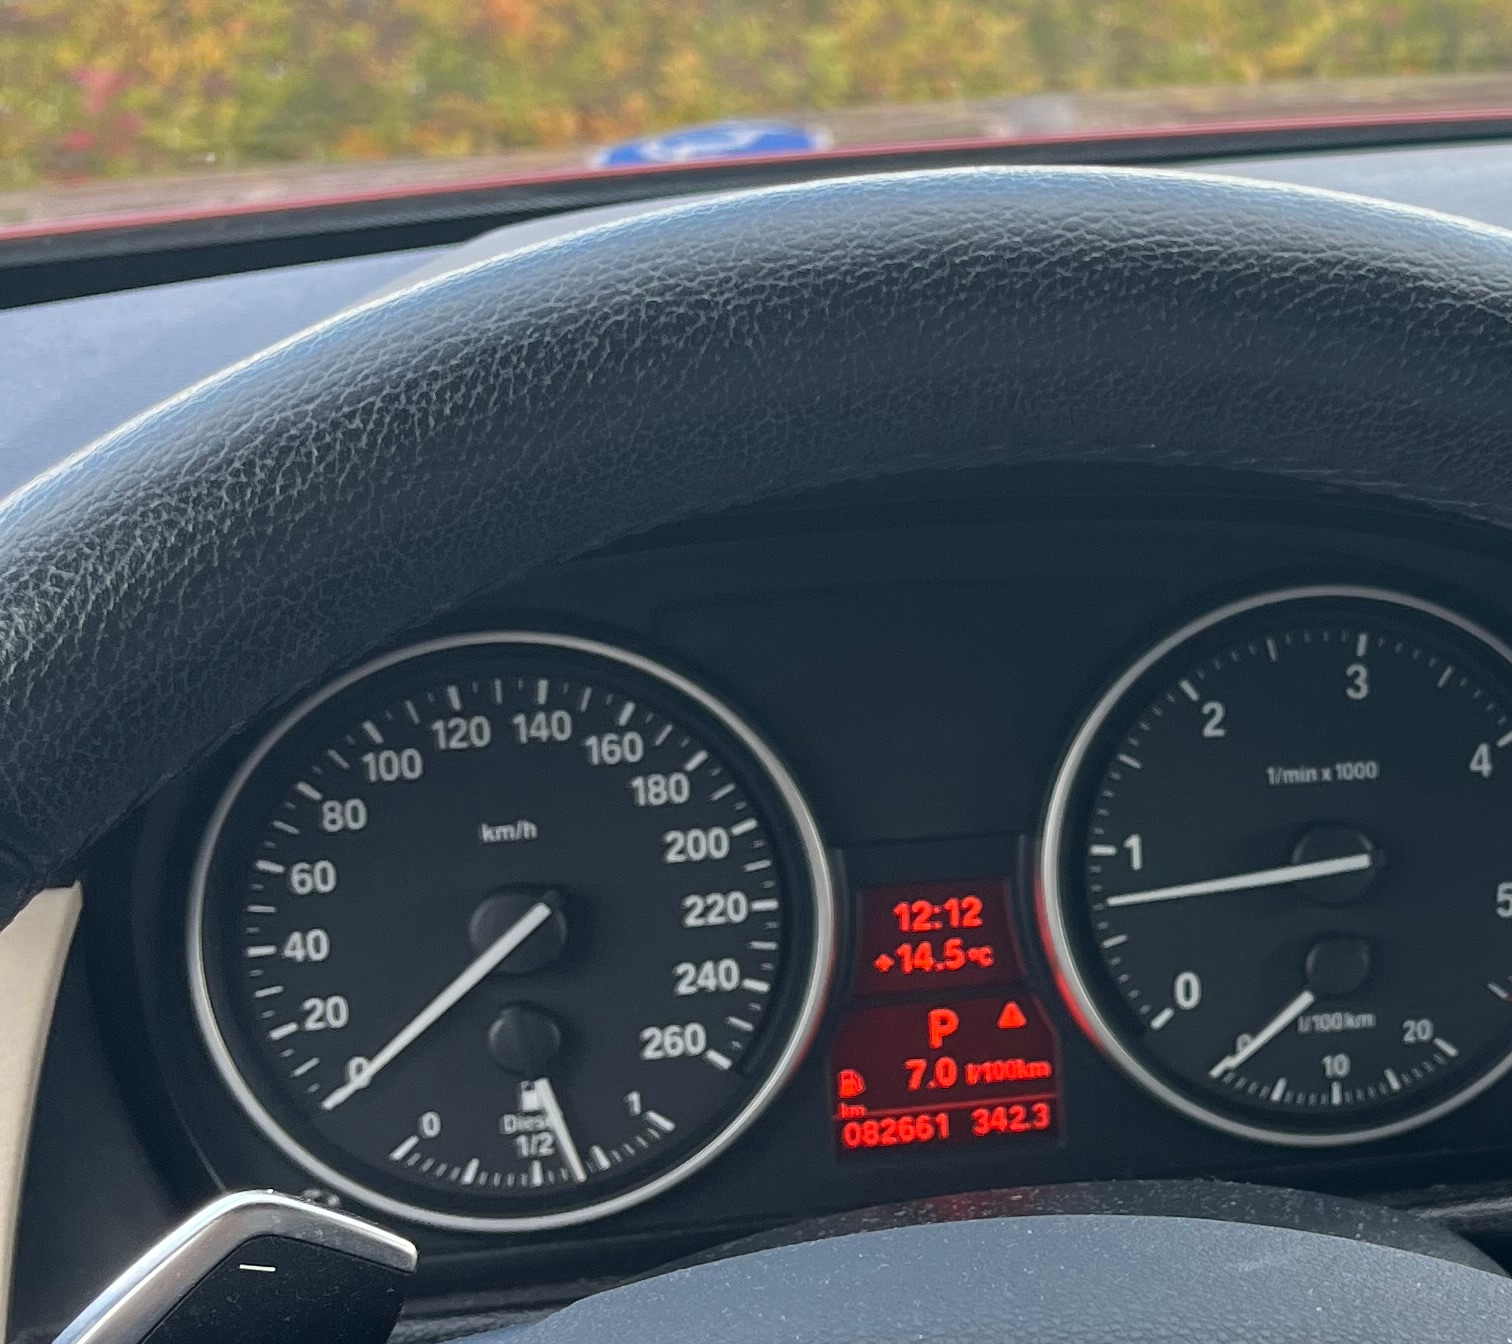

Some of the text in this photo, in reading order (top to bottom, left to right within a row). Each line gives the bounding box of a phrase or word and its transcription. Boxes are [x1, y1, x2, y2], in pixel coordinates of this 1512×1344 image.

[1345, 664, 1369, 700] 3
[431, 716, 491, 751] 120
[513, 710, 573, 743] 140
[1202, 702, 1226, 739] 2
[584, 730, 645, 766] 160
[1469, 743, 1492, 778] 4
[362, 748, 424, 784] 100
[1266, 761, 1379, 787] 1/min x 1000
[631, 771, 691, 807] 180
[322, 799, 367, 832] 80
[481, 819, 538, 844] km/h
[664, 826, 730, 864] 200
[1124, 834, 1142, 870] 1
[290, 860, 336, 895] 60
[683, 891, 749, 928] 220
[893, 895, 983, 932] 12:12
[283, 929, 330, 962] 40
[674, 959, 741, 996] 240
[1173, 971, 1201, 1010] 0
[302, 996, 349, 1032] 20
[928, 1008, 960, 1049] P
[1402, 1019, 1434, 1043] 20
[640, 1024, 707, 1060] 260
[347, 1056, 372, 1090] 0
[905, 1056, 958, 1091] 7.0
[1321, 1053, 1351, 1078] 10
[626, 1091, 642, 1116] 1
[839, 1102, 866, 1119] km
[421, 1111, 441, 1138] 0
[842, 1103, 1050, 1148] 082661 342.3
[516, 1131, 555, 1157] 1/2
